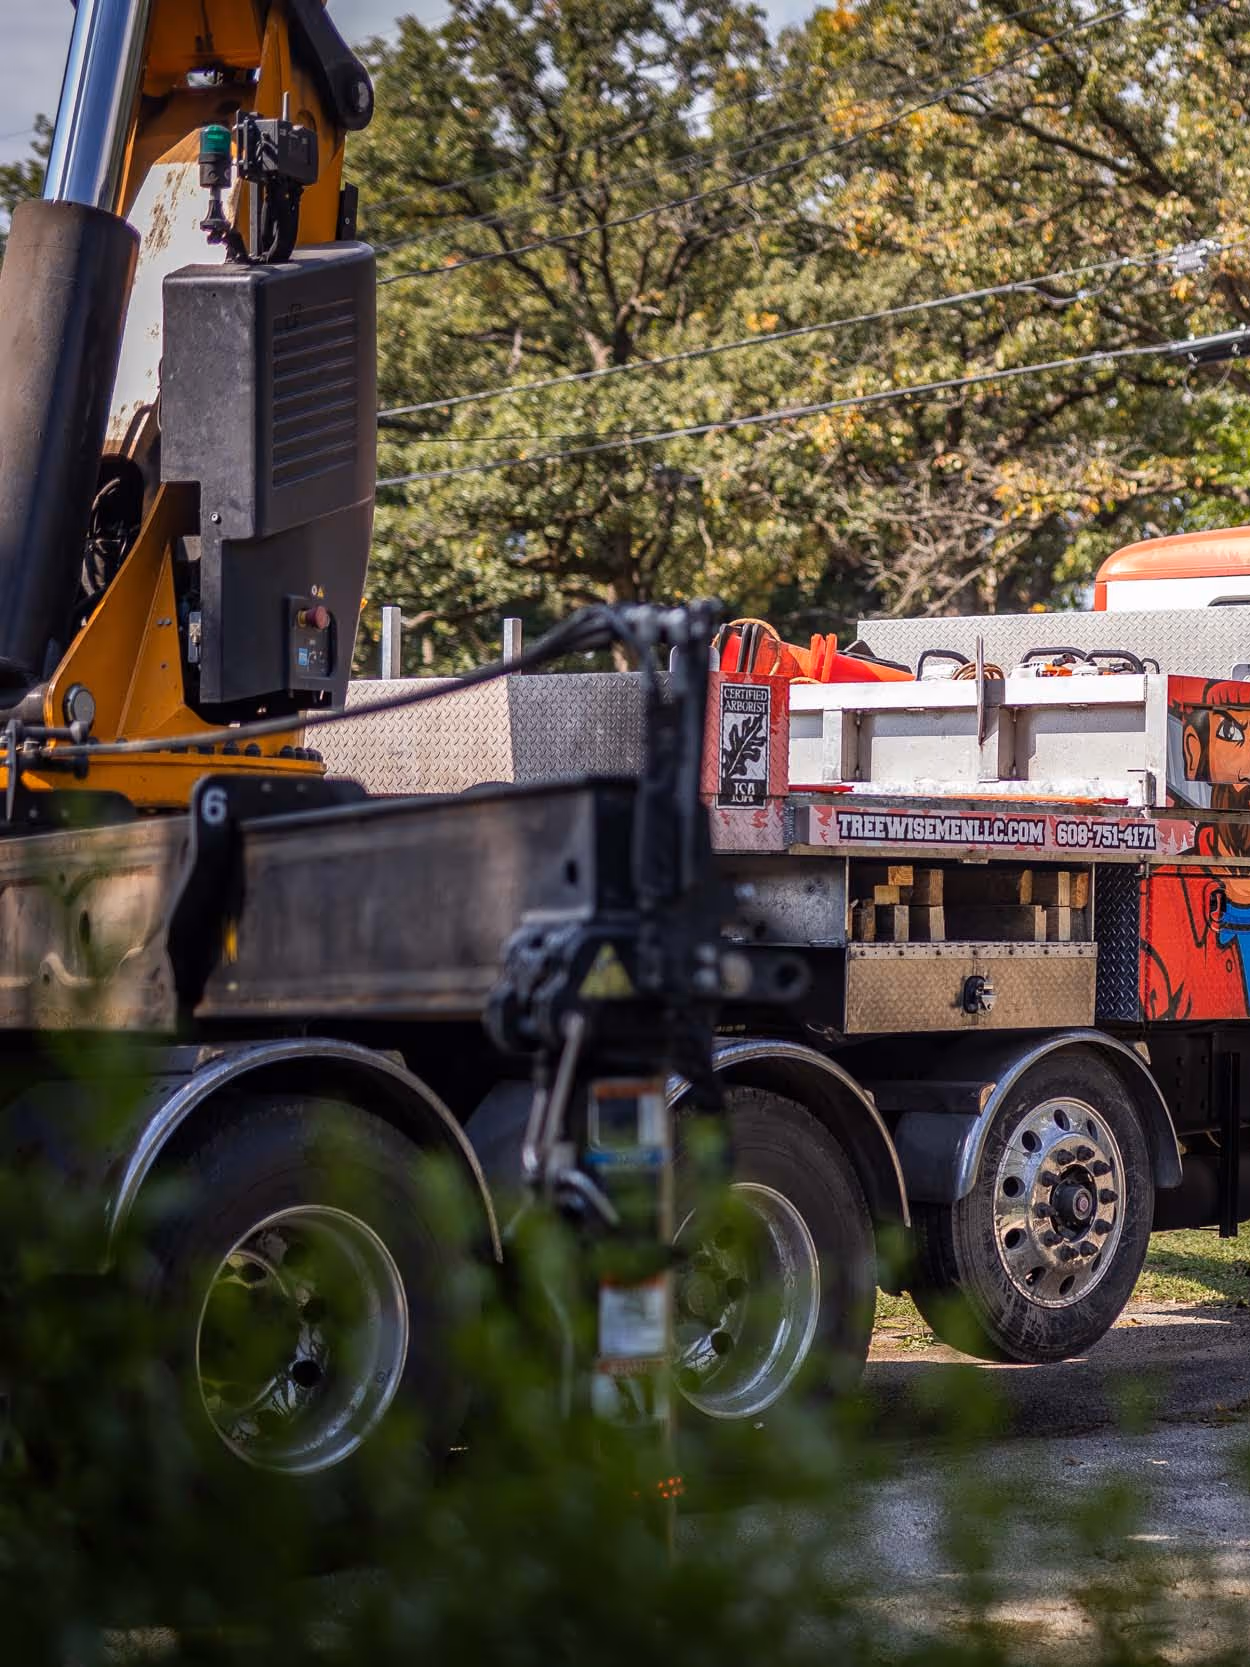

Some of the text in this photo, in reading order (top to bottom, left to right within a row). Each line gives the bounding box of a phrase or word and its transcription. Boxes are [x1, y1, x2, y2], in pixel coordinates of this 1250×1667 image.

[723, 688, 768, 701] CERTIFIED
[724, 701, 768, 713] ARBORIST
[730, 782, 756, 803] ISA
[202, 788, 227, 824] 6
[838, 813, 1156, 848] TREEWISEMENLLC.COM 608-751-4171
